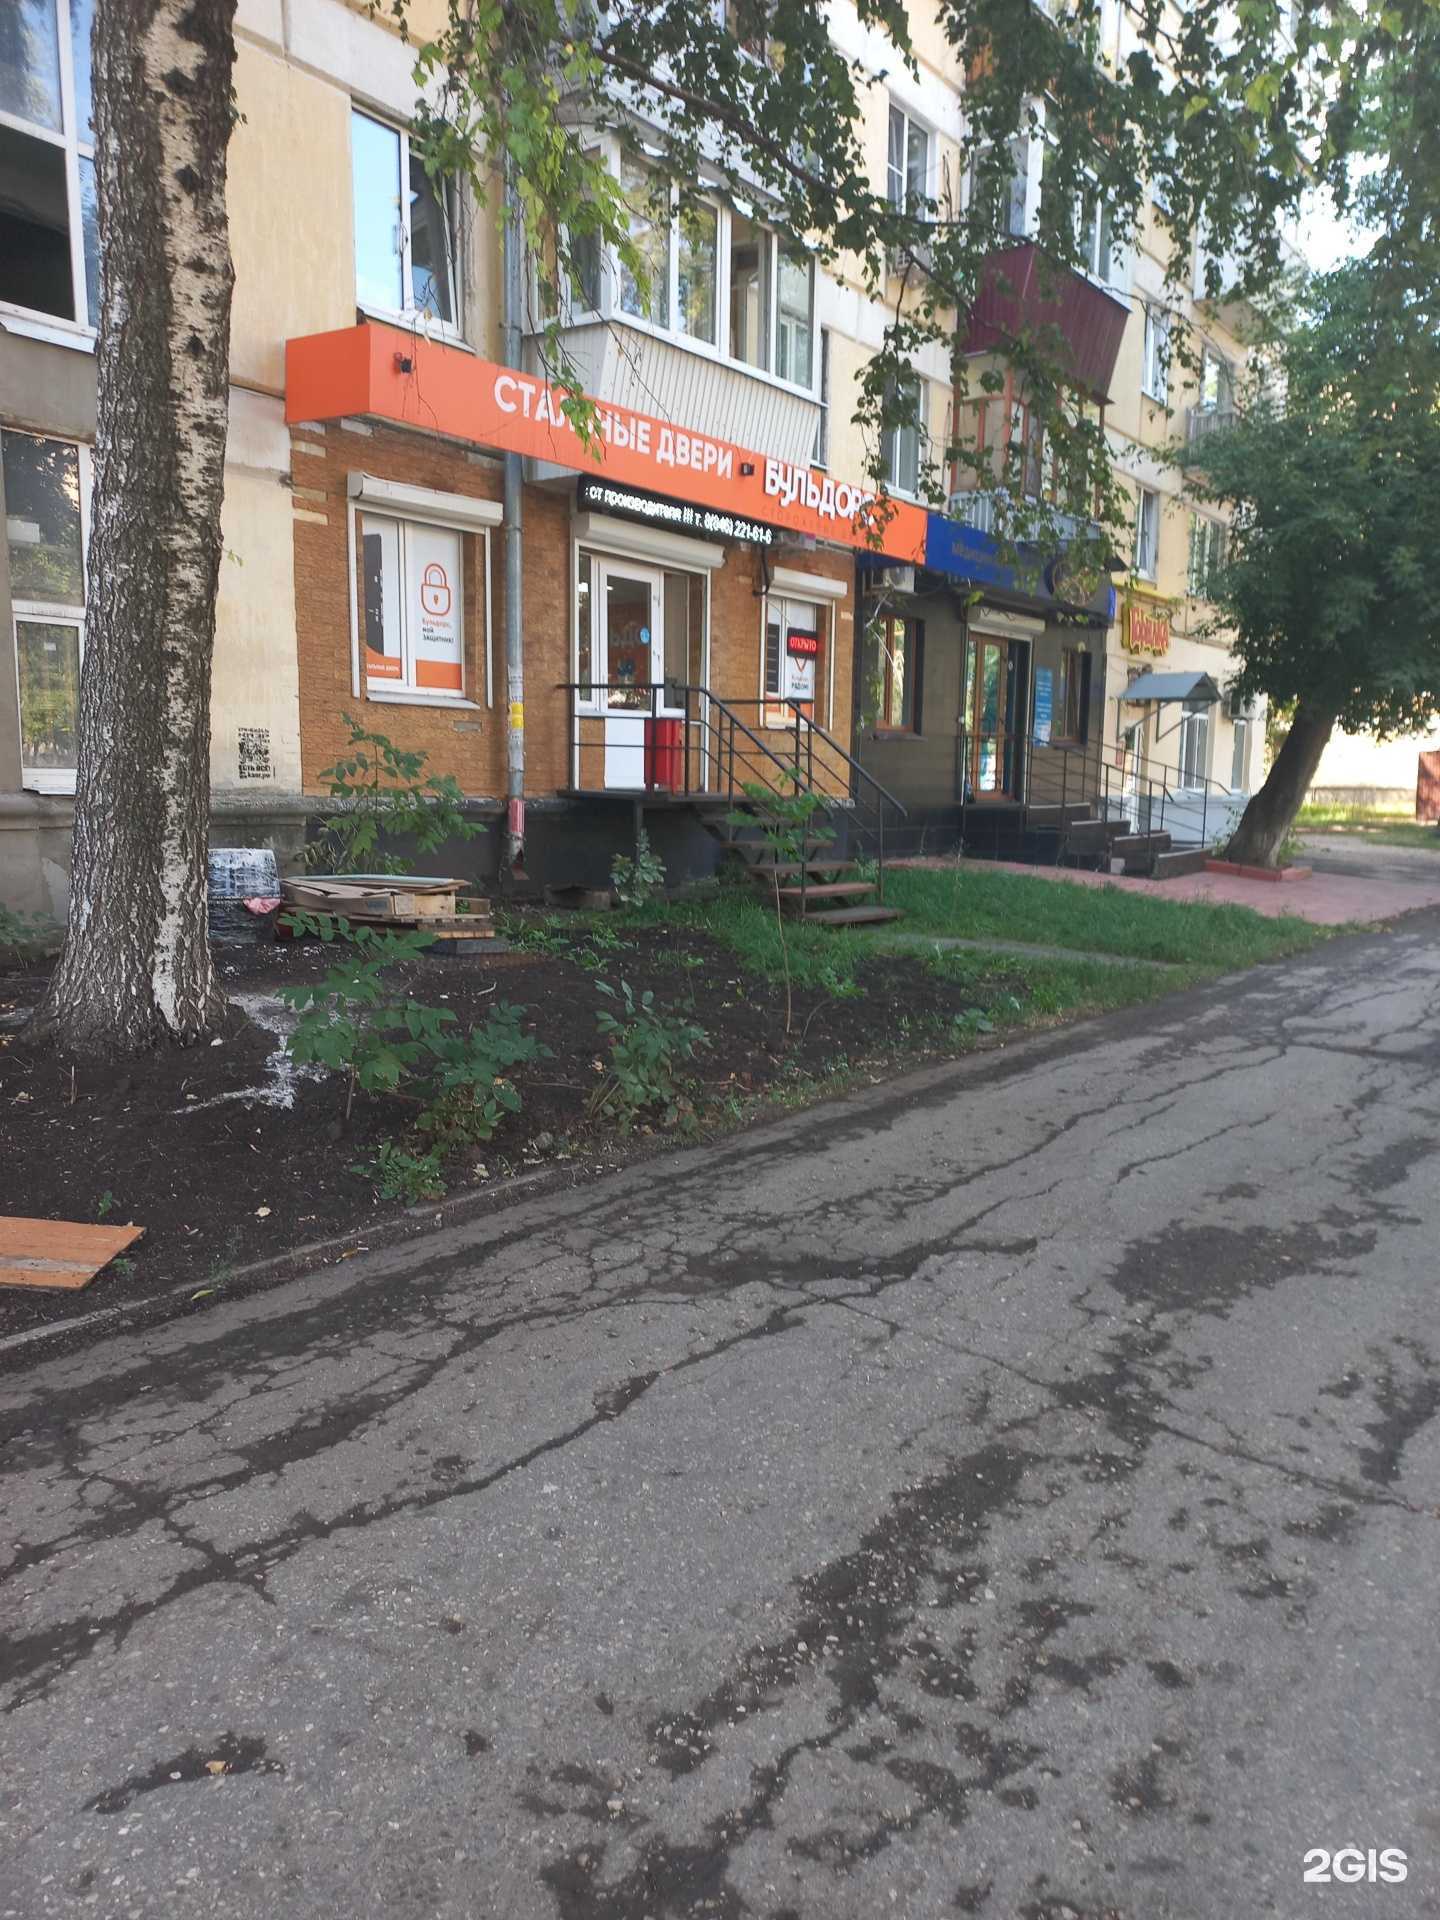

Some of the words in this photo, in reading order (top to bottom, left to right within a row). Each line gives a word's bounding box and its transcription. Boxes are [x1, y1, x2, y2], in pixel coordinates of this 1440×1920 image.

[493, 374, 651, 455] СТАЛНЫЕ
[656, 427, 733, 480] ДВЕРИ
[791, 636, 816, 652] ОТКРЫТО
